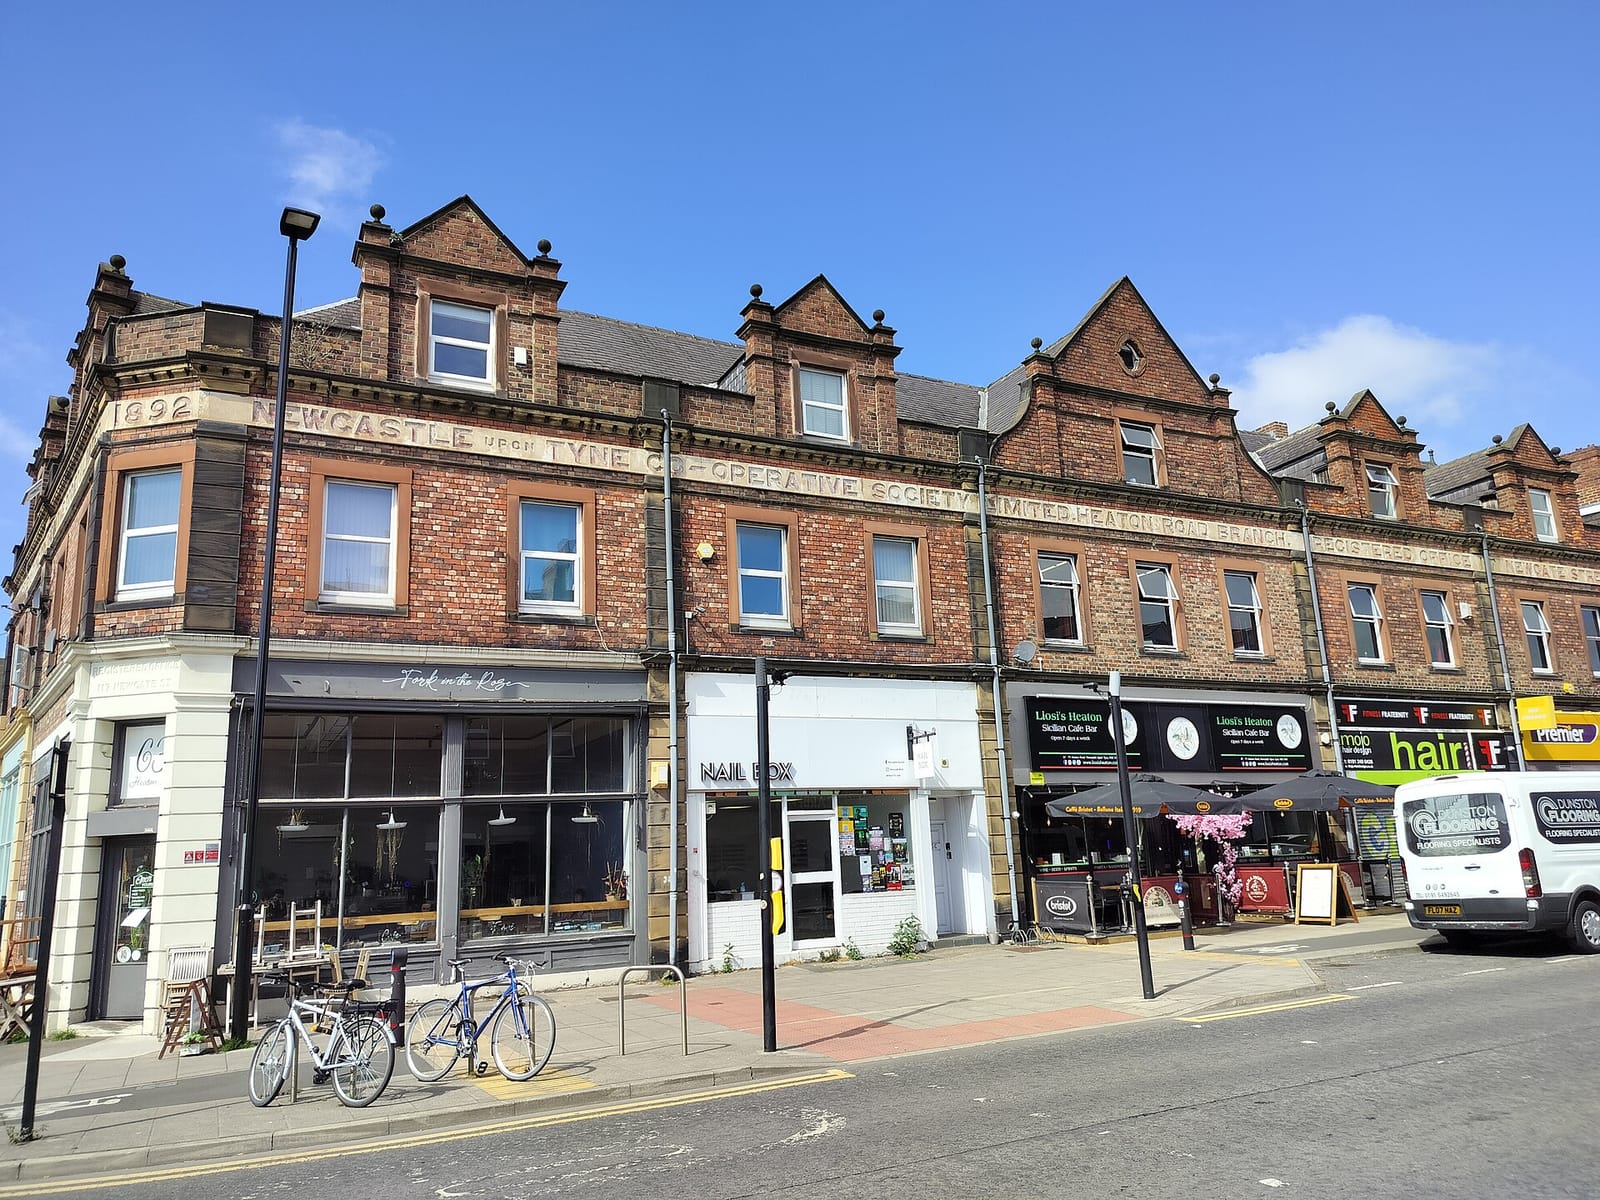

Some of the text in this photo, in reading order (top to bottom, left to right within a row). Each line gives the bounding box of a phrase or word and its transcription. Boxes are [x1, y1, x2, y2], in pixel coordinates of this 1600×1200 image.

[113, 396, 192, 428] 1892
[252, 401, 474, 450] NEWCASTLE
[484, 436, 535, 452] UPON
[545, 439, 630, 468] TYNE
[870, 481, 970, 510] SOCIETY
[1079, 509, 1154, 532] HEATON
[1163, 516, 1209, 538] ROAD
[1311, 535, 1473, 568] REGISTERED OFFICE
[382, 669, 438, 692] Fork
[440, 678, 455, 687] in
[455, 672, 473, 687] the
[1069, 711, 1103, 722] Heaton
[1244, 717, 1273, 727] Heaton
[1041, 723, 1098, 733] Sicilian Cafe Bar
[1222, 728, 1270, 737] Sicilian Cafe Bar
[1536, 728, 1584, 742] Premier
[1340, 731, 1371, 752] mojo
[1389, 731, 1463, 770] hair
[700, 762, 747, 782] NAIL
[1557, 798, 1598, 809] DUNSTON
[1437, 804, 1498, 819] DUNSTON
[1422, 816, 1500, 835] FLOORING
[1545, 829, 1573, 837] FLOORING
[1416, 836, 1502, 850] FLOORING SPECIALISTS
[1050, 900, 1072, 911] bristot
